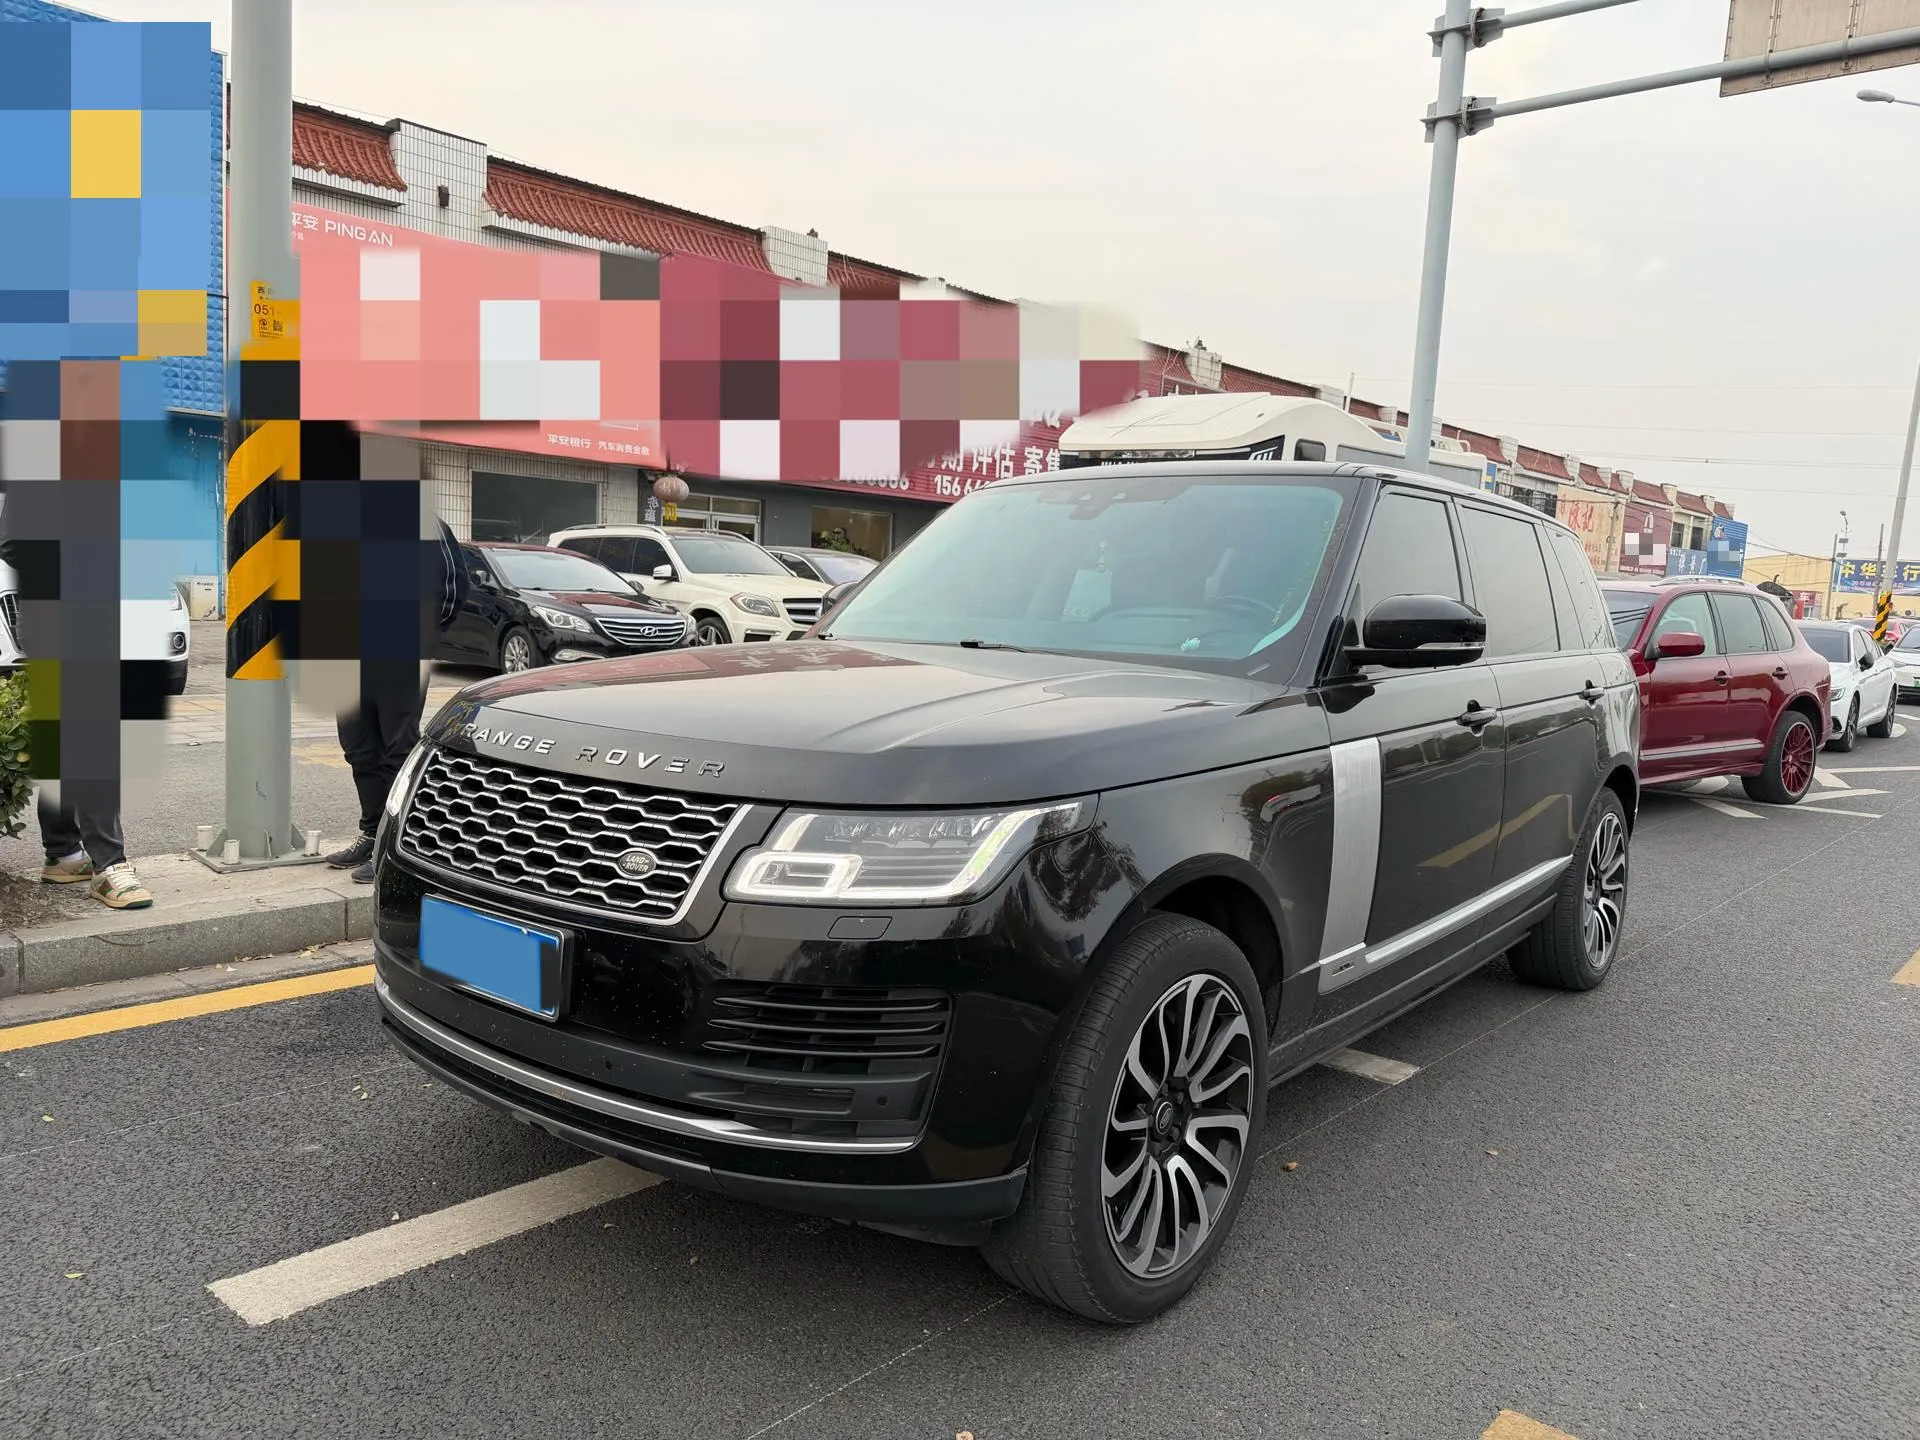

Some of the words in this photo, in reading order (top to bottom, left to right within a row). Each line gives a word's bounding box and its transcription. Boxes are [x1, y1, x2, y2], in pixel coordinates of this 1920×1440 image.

[547, 433, 592, 449] 平安银行
[460, 722, 556, 755] RANGE
[575, 745, 725, 778] ROVER
